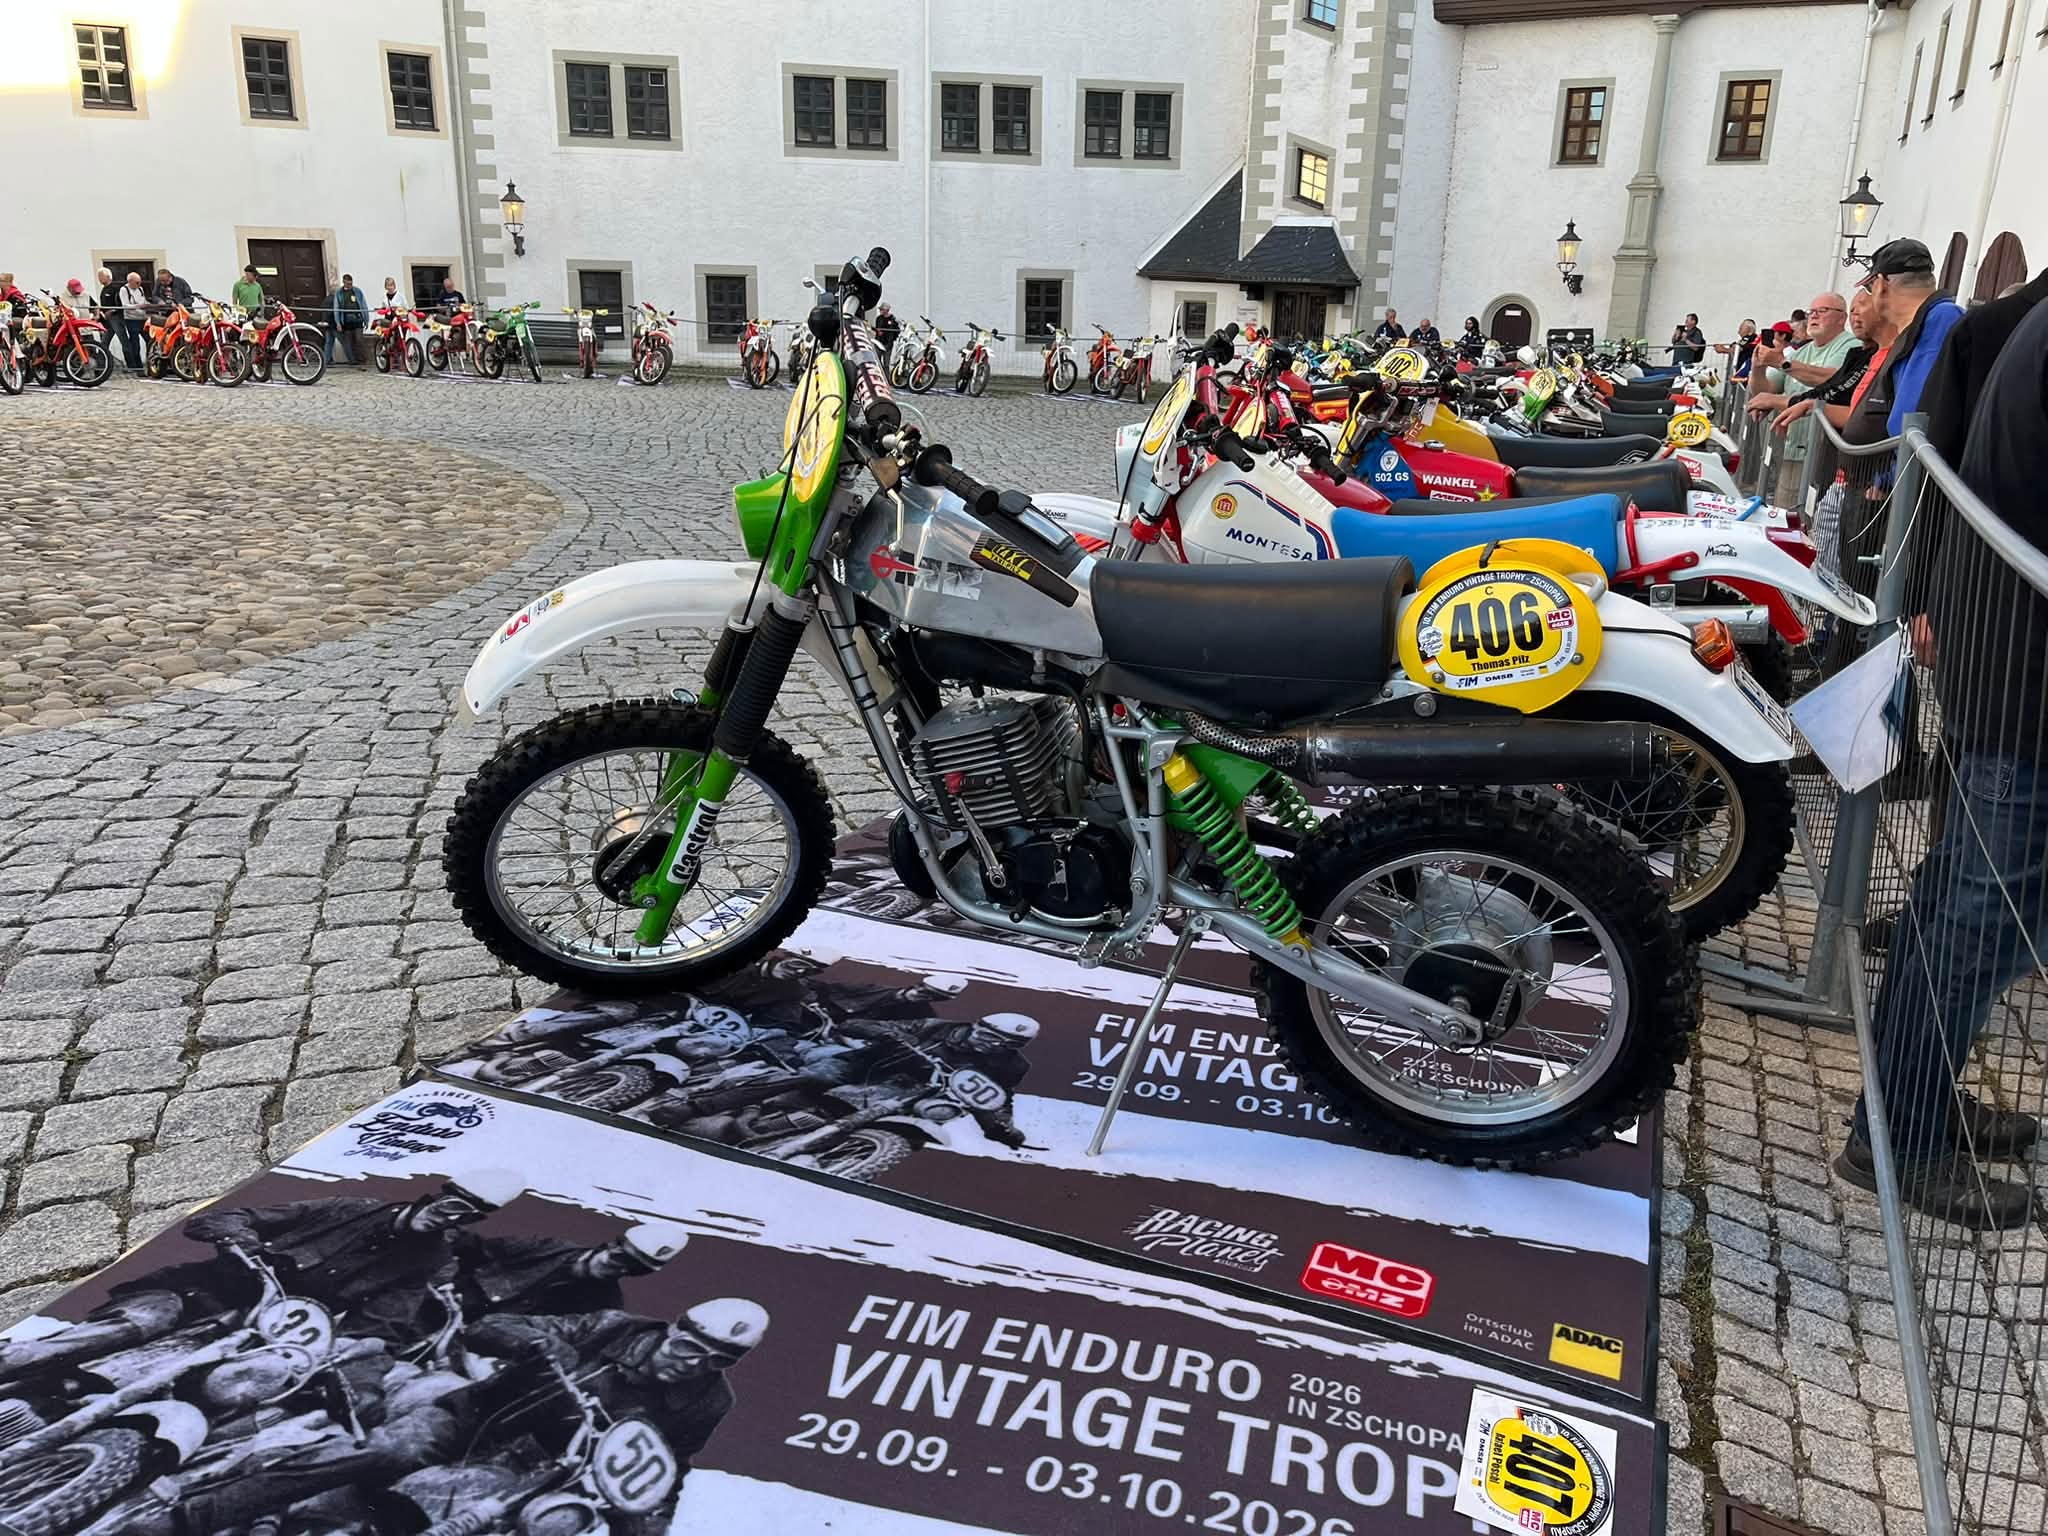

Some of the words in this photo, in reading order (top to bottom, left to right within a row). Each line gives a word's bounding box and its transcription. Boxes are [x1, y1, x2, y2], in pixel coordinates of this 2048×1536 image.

[1385, 357, 1410, 378] 402
[1680, 424, 1700, 437] 397
[1375, 472, 1393, 483] 502
[1394, 471, 1410, 483] GS
[1422, 474, 1478, 490] WANKEL
[1225, 528, 1313, 561] MONTESA
[1705, 544, 1738, 558] Masella
[1427, 601, 1440, 615] FIM
[1436, 582, 1465, 605] ENDURO
[1463, 572, 1495, 588] VINTAGE
[1496, 571, 1527, 581] TROPHY
[1529, 576, 1566, 604] ZSCHOPAU
[1484, 586, 1494, 596] C
[1450, 591, 1544, 661] 406
[1547, 610, 1571, 622] MC
[1471, 658, 1510, 672] Thomas
[1511, 654, 1530, 665] Pilz
[1456, 676, 1478, 688] FIM
[1485, 673, 1514, 682] DMSB
[671, 803, 721, 880] Castrol
[1094, 1013, 1177, 1045] FIM
[1189, 1028, 1280, 1057] END
[1088, 1037, 1299, 1093] VNTAG
[957, 1074, 999, 1106] 50
[1429, 1071, 1524, 1094] ZSCHOPA
[384, 1100, 424, 1112] FIM
[1134, 1208, 1279, 1250] RACING
[1133, 1232, 1285, 1274] Planet
[1315, 1249, 1427, 1292] MC
[1463, 1322, 1483, 1336] im
[1487, 1330, 1536, 1351] ADAC
[1465, 1312, 1534, 1339] Ortsclub
[1556, 1325, 1622, 1354] ADAC
[848, 1295, 971, 1350] FIM
[981, 1317, 1262, 1402] ENDURO
[1289, 1373, 1362, 1405] 2026
[827, 1343, 1192, 1463] VINTAGE
[1216, 1410, 1490, 1535] TROP
[1287, 1395, 1317, 1420] IN
[1325, 1406, 1465, 1457] ZSCHOPA
[784, 1412, 958, 1477] 29.09.
[986, 1465, 1004, 1475] -
[1476, 1439, 1487, 1464] DMSB
[1493, 1432, 1506, 1458] Rafael
[604, 1435, 667, 1500] 50
[1504, 1434, 1577, 1518] 407
[1579, 1483, 1590, 1491] C
[1531, 1512, 1541, 1531] MC
[1587, 1498, 1605, 1523] TROPHY
[1550, 1522, 1588, 1536] ZSCHOPAU
